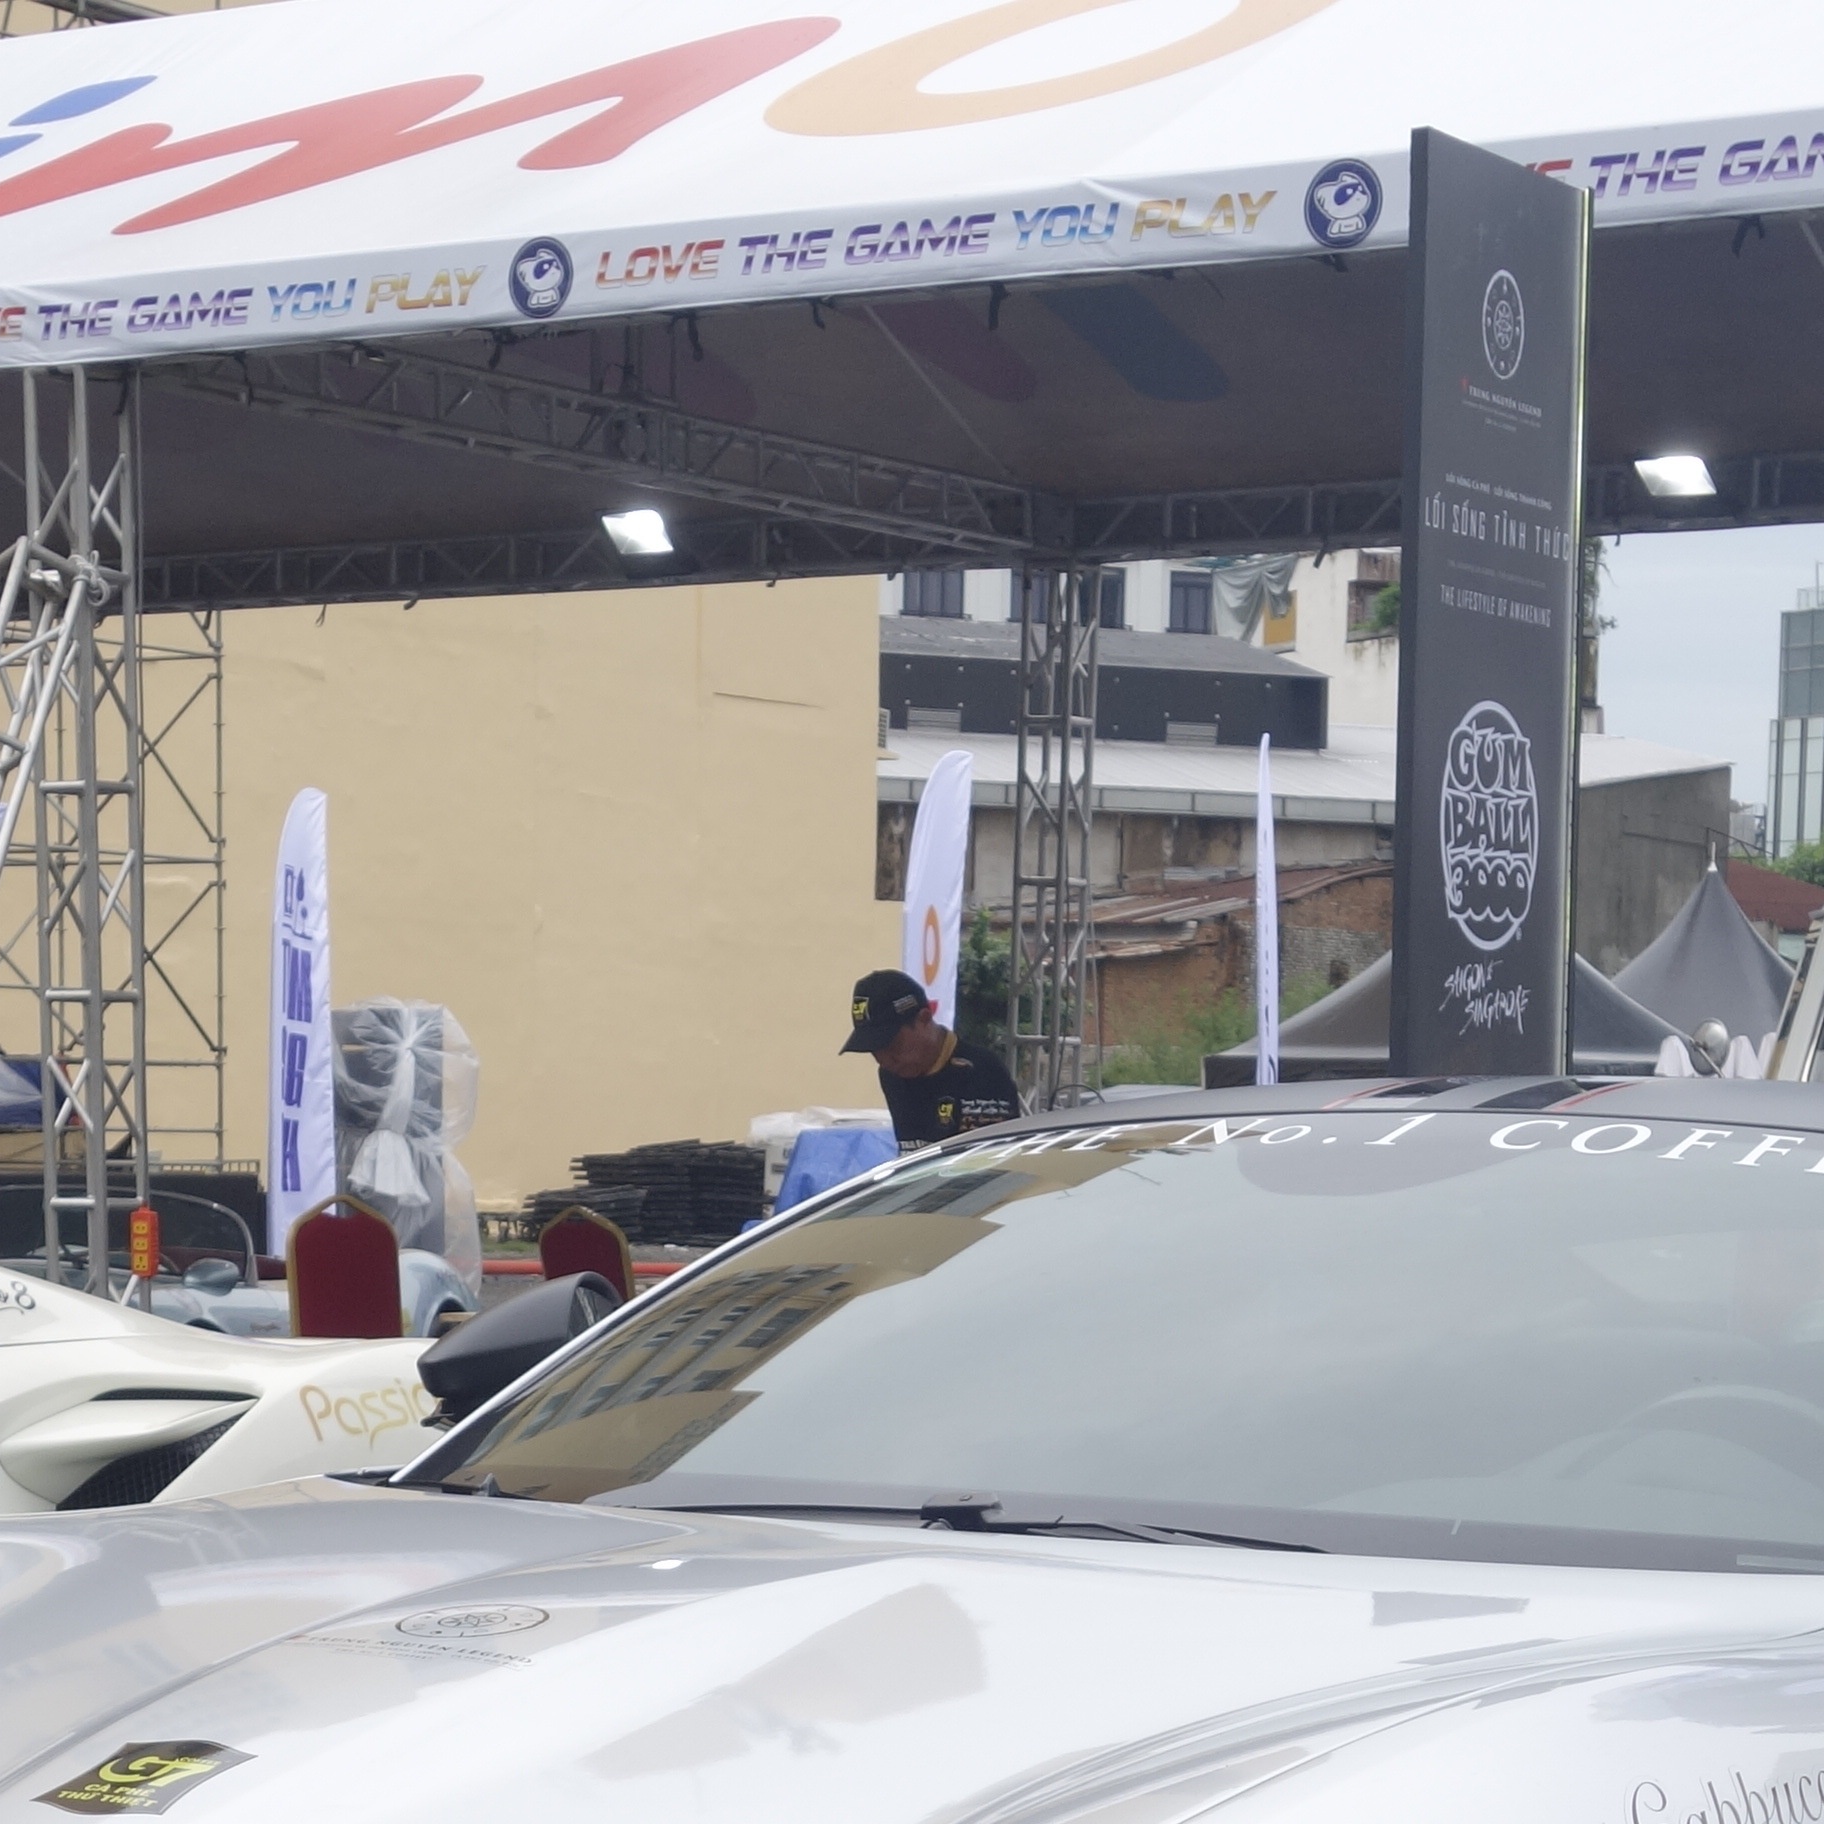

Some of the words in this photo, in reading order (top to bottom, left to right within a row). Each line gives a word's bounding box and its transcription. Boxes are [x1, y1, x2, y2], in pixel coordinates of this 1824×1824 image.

[1586, 145, 1707, 198] THE
[595, 239, 726, 290] LOVE
[738, 228, 834, 277] THE
[843, 213, 997, 265] GAME
[1011, 202, 1120, 250] YOU
[1129, 190, 1279, 243] PLAY
[37, 299, 112, 341] THE
[127, 287, 253, 334] GAME
[267, 278, 356, 322] YOU
[365, 265, 487, 314] PLAY
[1452, 499, 1487, 542] SỐNG
[1440, 584, 1456, 608] THE
[1449, 721, 1532, 797] GUM
[1447, 792, 1534, 853] BALL
[11, 1280, 37, 1311] 8
[299, 1377, 440, 1452] Passio
